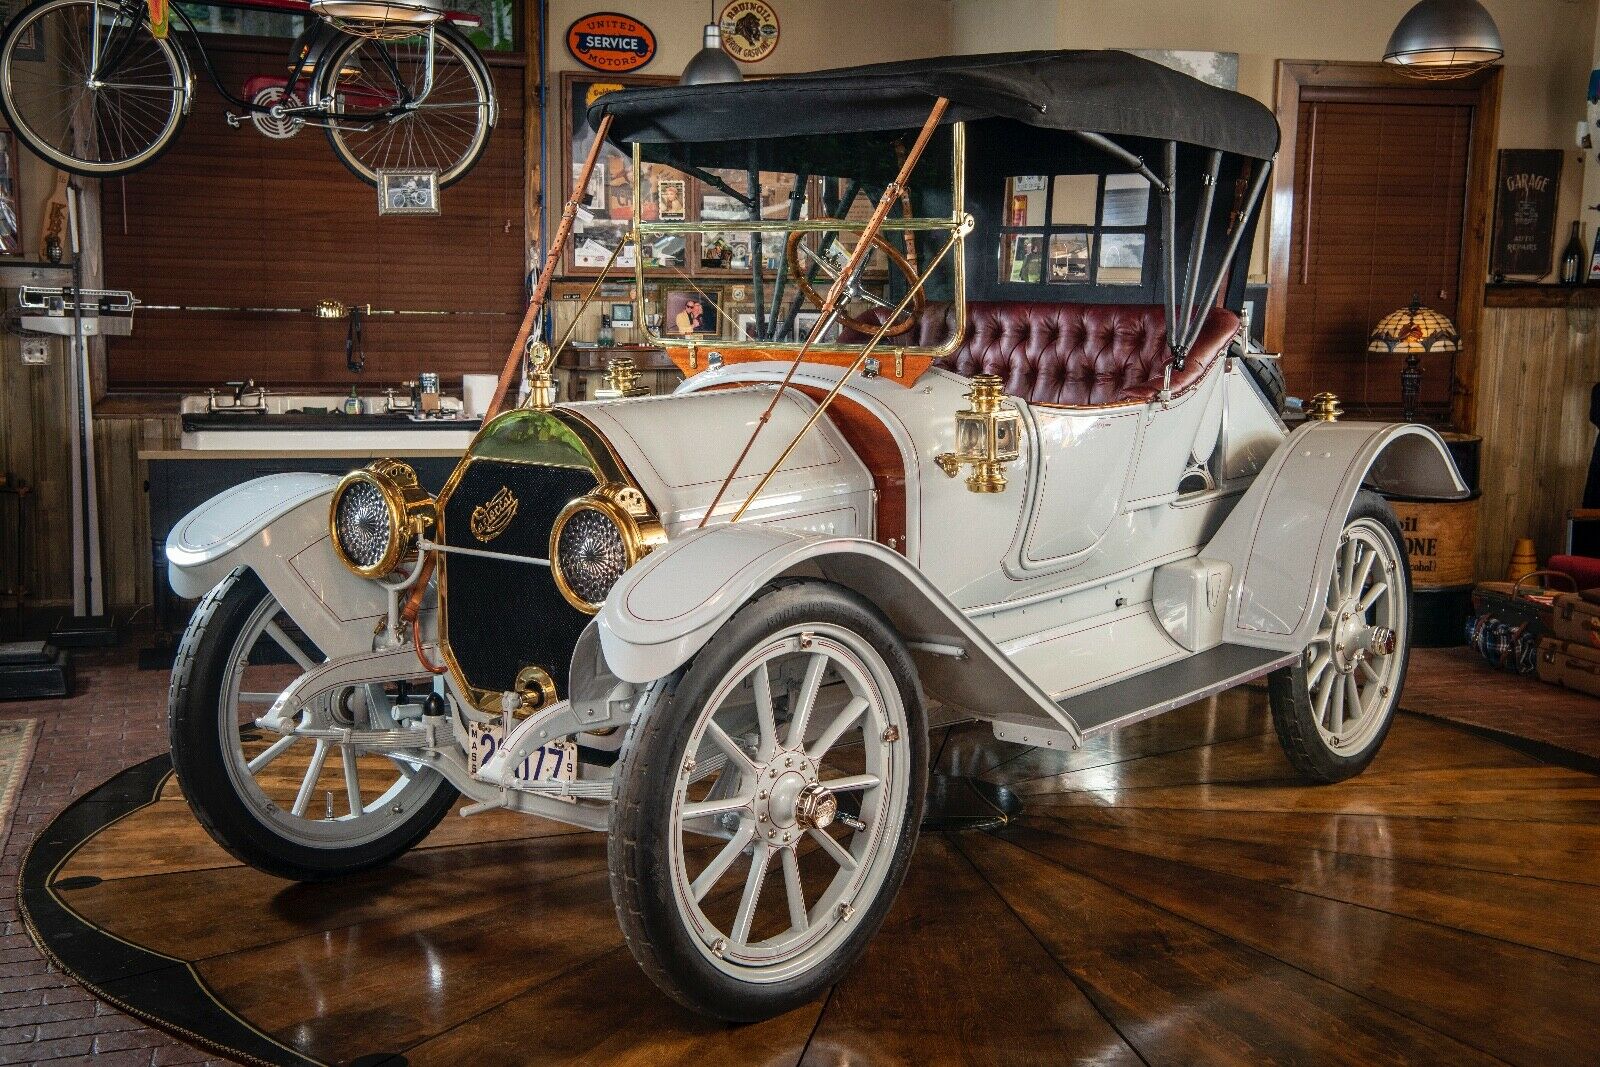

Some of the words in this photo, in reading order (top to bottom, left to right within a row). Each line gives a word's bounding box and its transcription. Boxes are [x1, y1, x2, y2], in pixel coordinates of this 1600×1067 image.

[587, 21, 636, 32] UNITED
[586, 36, 638, 50] SERVICE
[588, 54, 637, 66] MOTORS
[1506, 173, 1549, 192] GARAGE
[1507, 243, 1537, 254] REPAIRS
